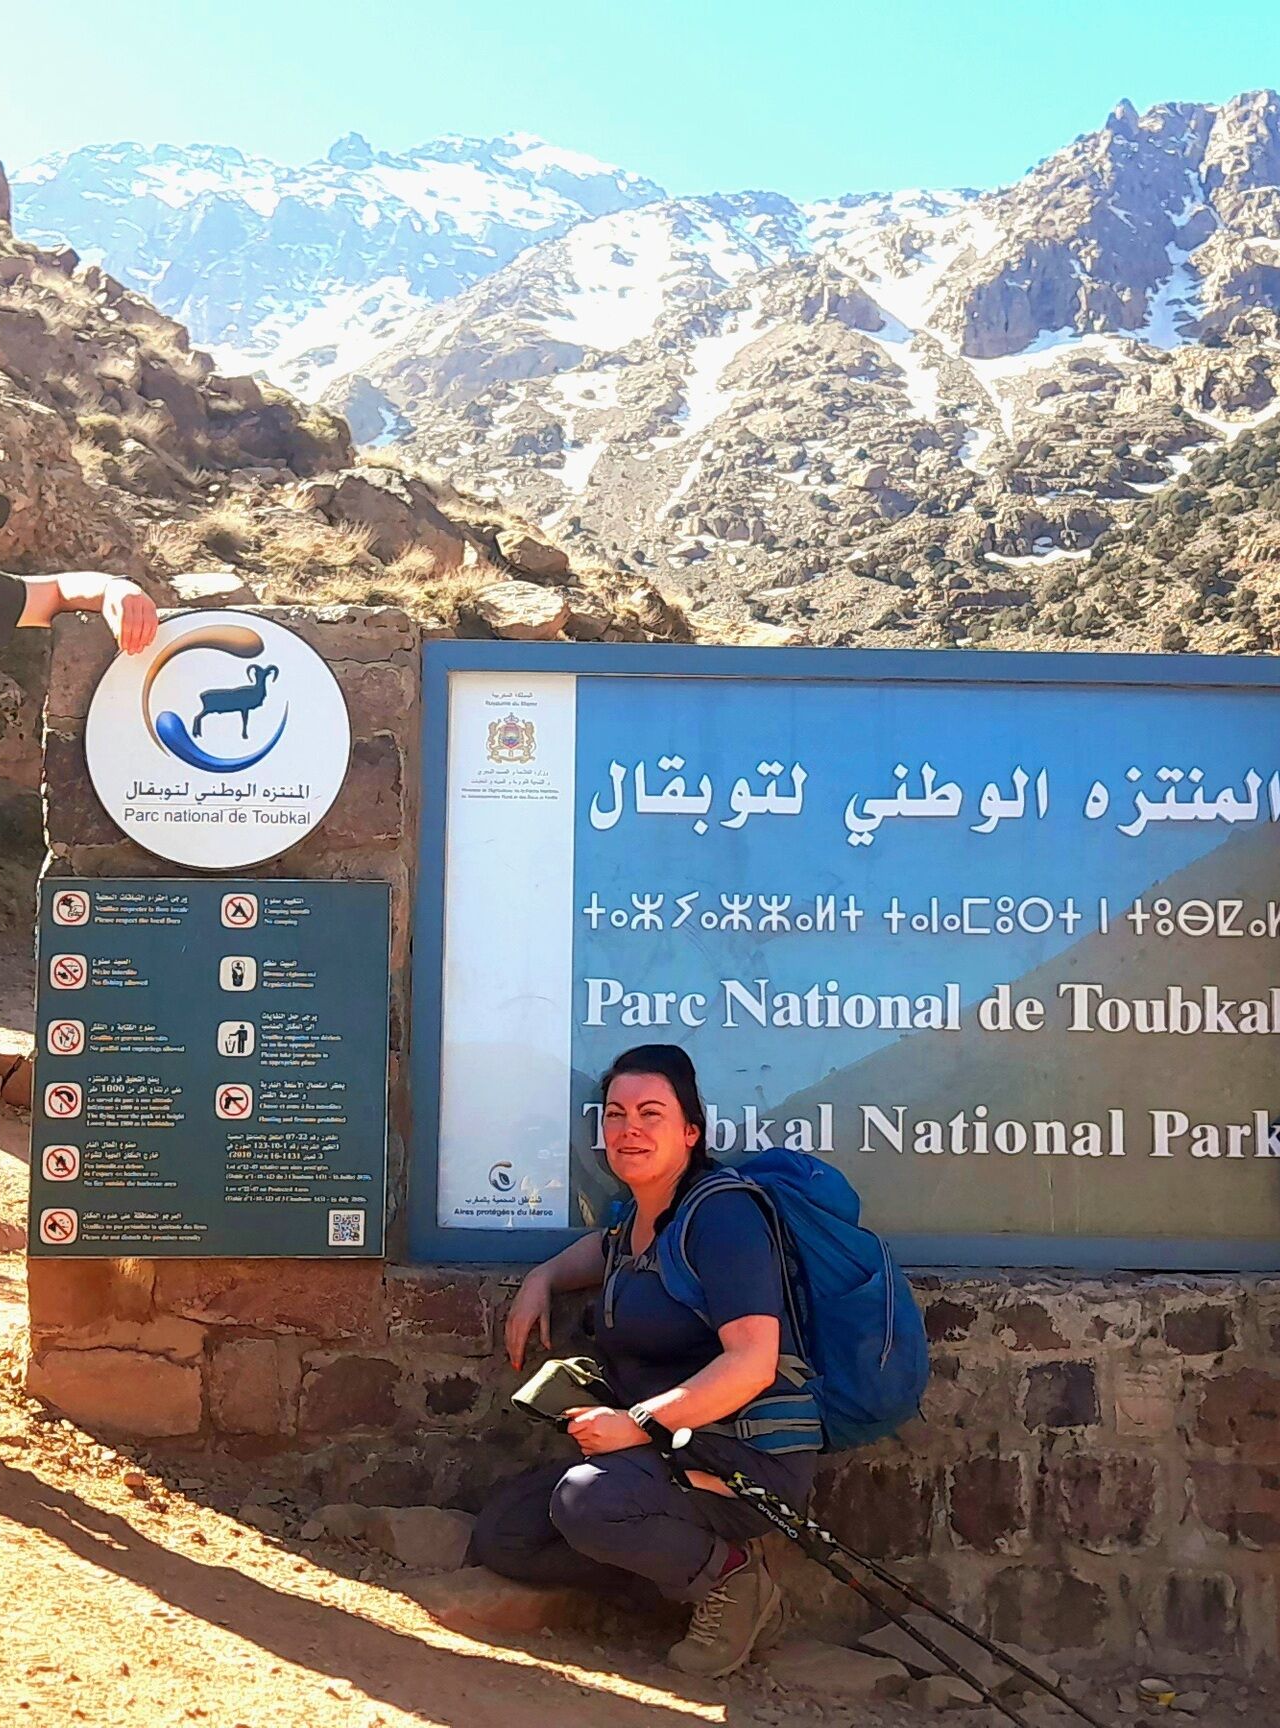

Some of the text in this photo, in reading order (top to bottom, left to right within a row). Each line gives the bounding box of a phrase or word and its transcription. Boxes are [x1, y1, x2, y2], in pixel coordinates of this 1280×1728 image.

[124, 808, 311, 825] Parc national de Toubkal
[126, 781, 310, 805] المنتزه الوطني لتوبقال
[589, 754, 809, 836] لتوبقال
[844, 761, 1049, 848] الوطني
[582, 977, 707, 1028] Parc
[720, 978, 962, 1031] National
[978, 983, 1046, 1032] de
[582, 1102, 835, 1153] Tbkal
[859, 1104, 1127, 1158] National
[757, 1502, 799, 1539] Quechua
